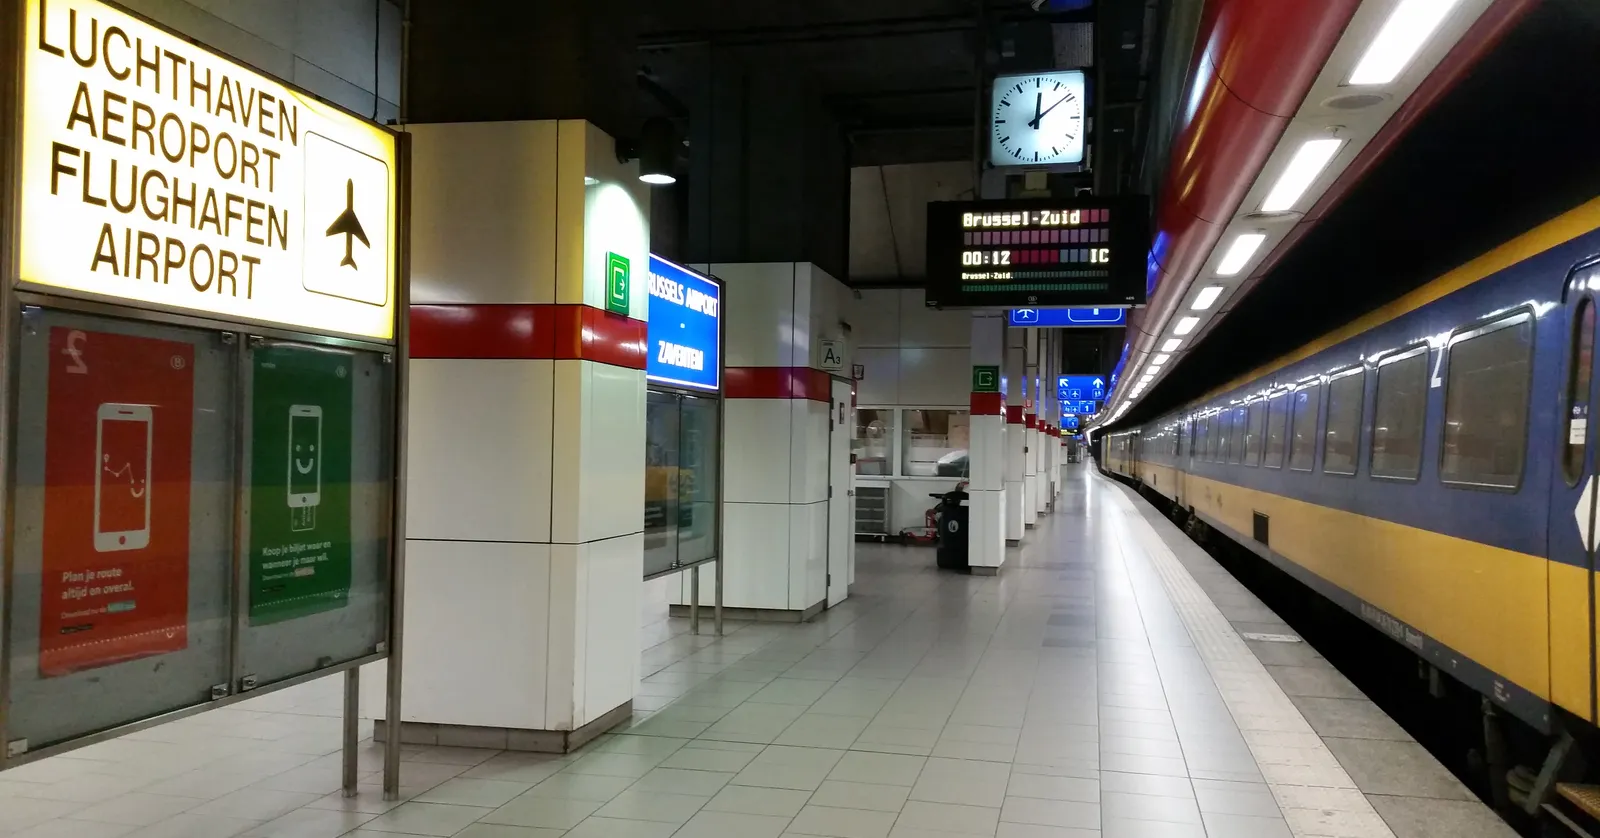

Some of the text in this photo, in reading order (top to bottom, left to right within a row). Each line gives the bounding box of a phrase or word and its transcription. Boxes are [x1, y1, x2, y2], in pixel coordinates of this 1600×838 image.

[38, 0, 298, 147] LUCHTHAVEN
[66, 81, 281, 193] AEROPORT
[50, 141, 288, 251] FLUGHAFEN
[962, 209, 1081, 227] Brussel-Zuid
[90, 223, 261, 300] AIRPORT
[962, 248, 1109, 266] 00:12 IC
[647, 271, 718, 317] RUSSELS AIRPORT
[658, 340, 704, 371] ZAVENTEM
[823, 347, 841, 365] A3
[262, 547, 281, 557] Koop
[62, 567, 122, 583] Plan je route
[61, 585, 87, 600] altijd
[89, 587, 101, 596] en
